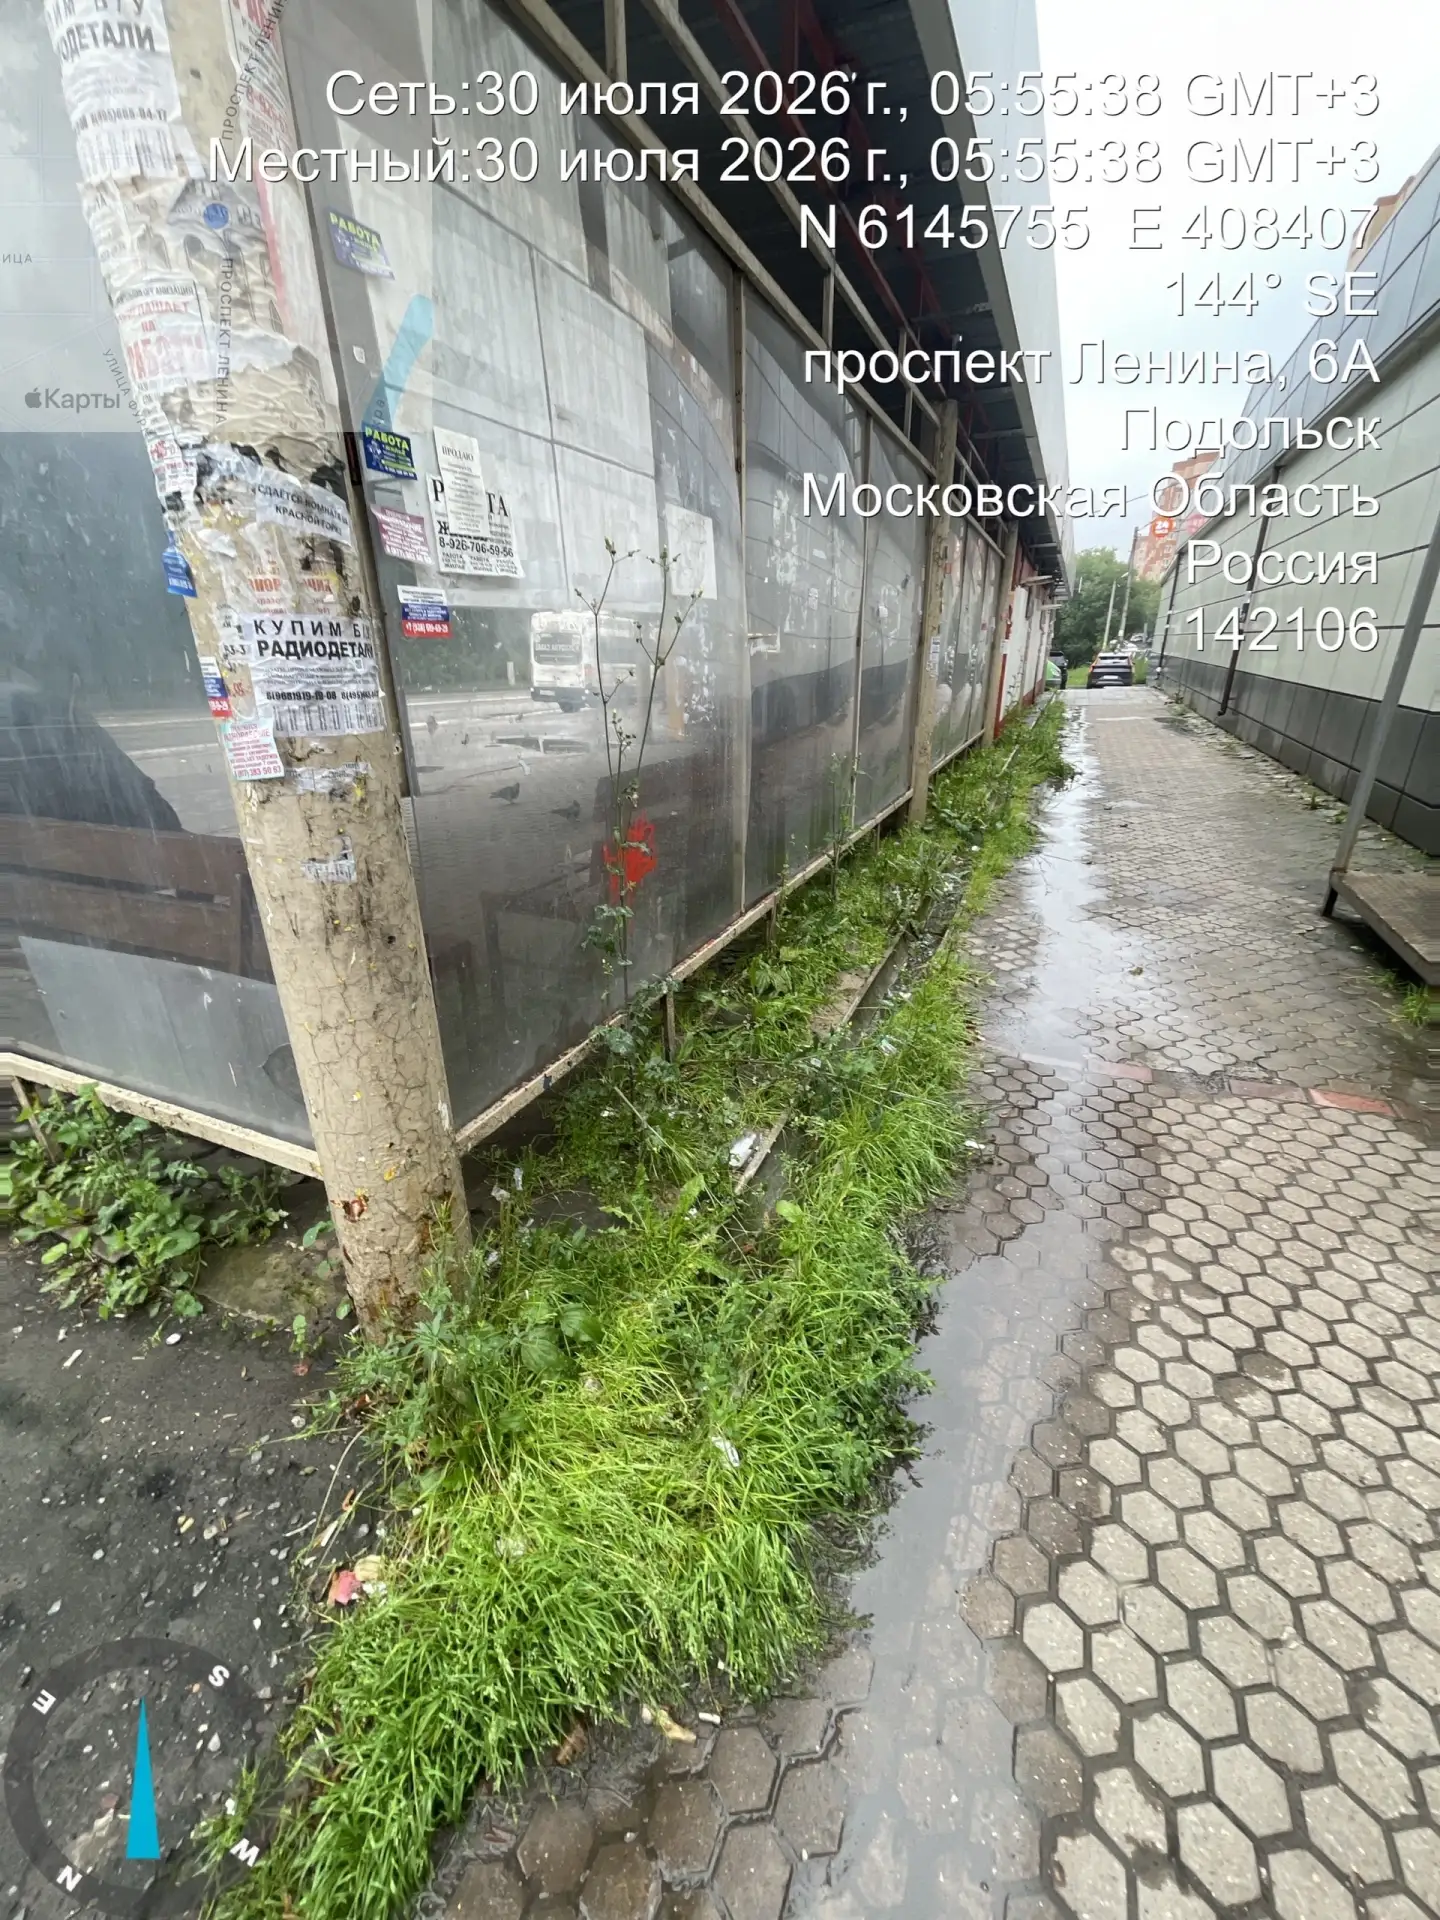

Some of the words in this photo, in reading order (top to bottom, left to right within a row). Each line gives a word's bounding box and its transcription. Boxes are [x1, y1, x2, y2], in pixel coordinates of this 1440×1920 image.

[365, 425, 410, 452] РАБОТА
[441, 445, 474, 462] ПРОДАЮ
[432, 478, 508, 518] РТА
[439, 536, 514, 558] 8-926-706-59-56
[254, 619, 343, 638] КУПИМ
[257, 639, 374, 660] РАДИОДЕТАЛИ
